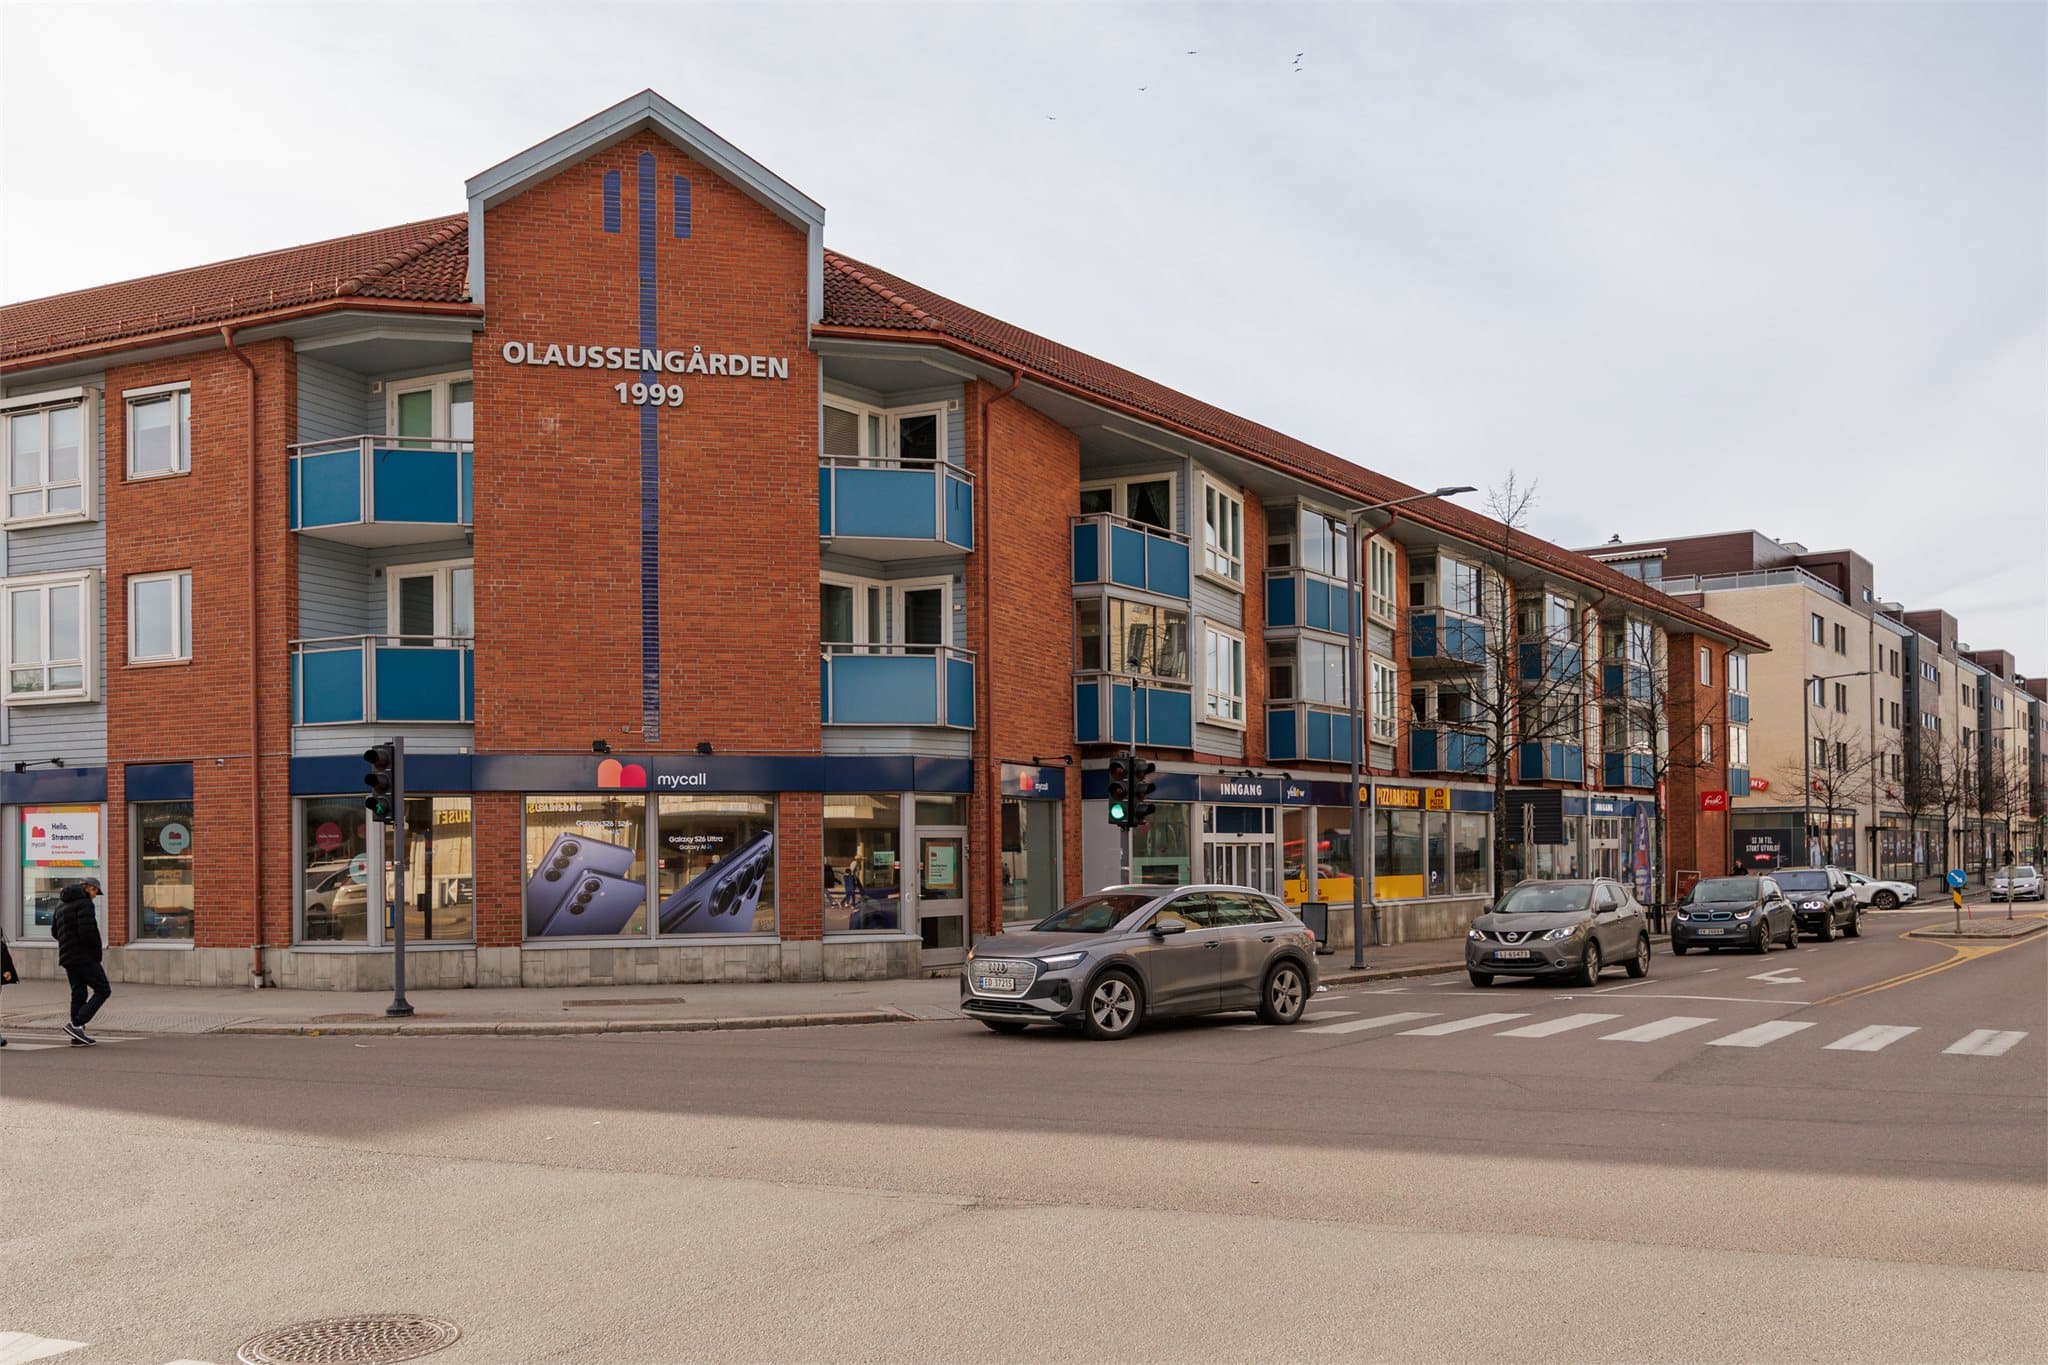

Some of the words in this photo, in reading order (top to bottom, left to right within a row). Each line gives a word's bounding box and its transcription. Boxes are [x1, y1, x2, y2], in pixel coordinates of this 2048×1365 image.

[502, 341, 788, 379] OLAUSSENGÅRDEN
[614, 382, 684, 407] 1999
[657, 773, 706, 788] mycall
[1750, 780, 1764, 788] NY
[1220, 783, 1262, 796] INNGANG
[668, 836, 694, 844] Galaxy
